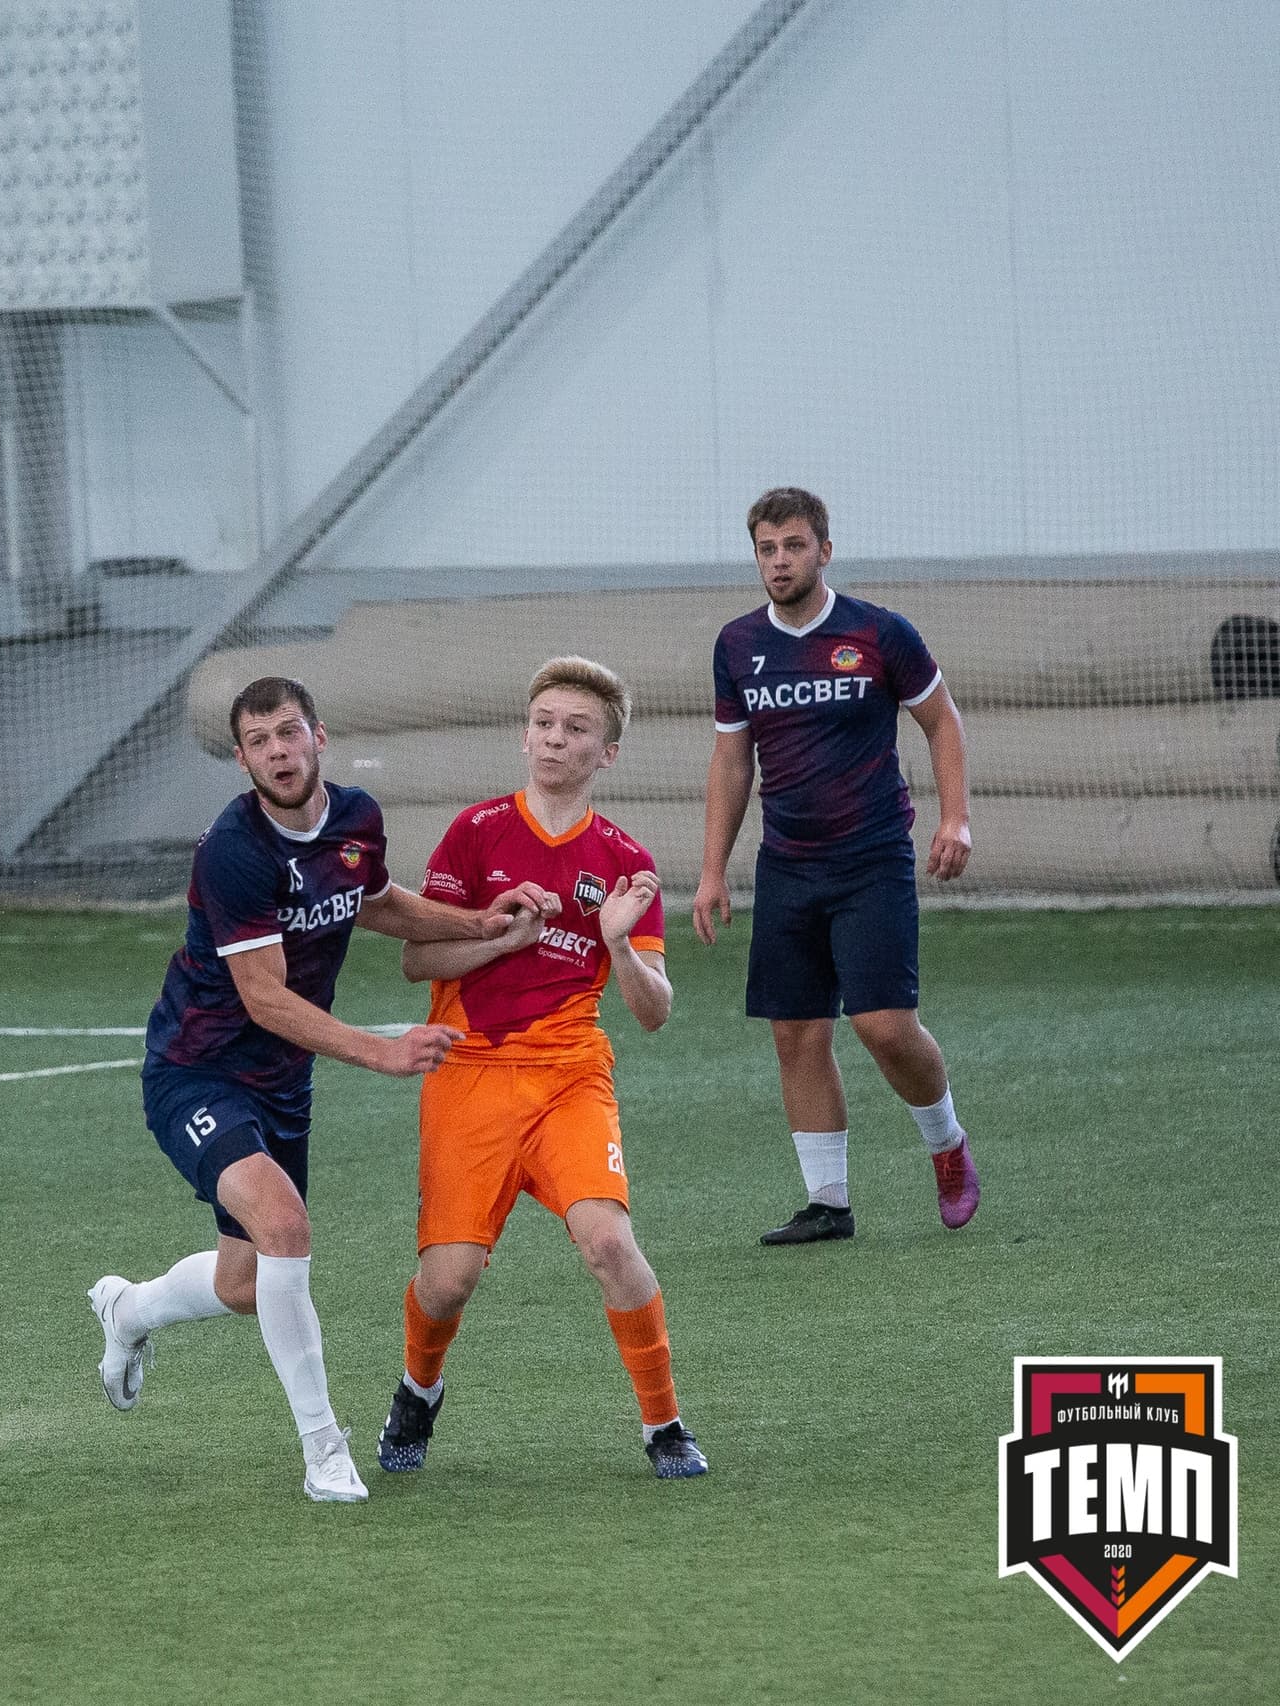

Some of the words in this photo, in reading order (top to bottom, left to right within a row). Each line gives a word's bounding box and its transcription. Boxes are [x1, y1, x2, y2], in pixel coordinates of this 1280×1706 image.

[752, 655, 766, 675] 7
[743, 677, 873, 711] РАССВЕТ
[578, 883, 604, 905] ТЕМП
[185, 1106, 217, 1147] 15
